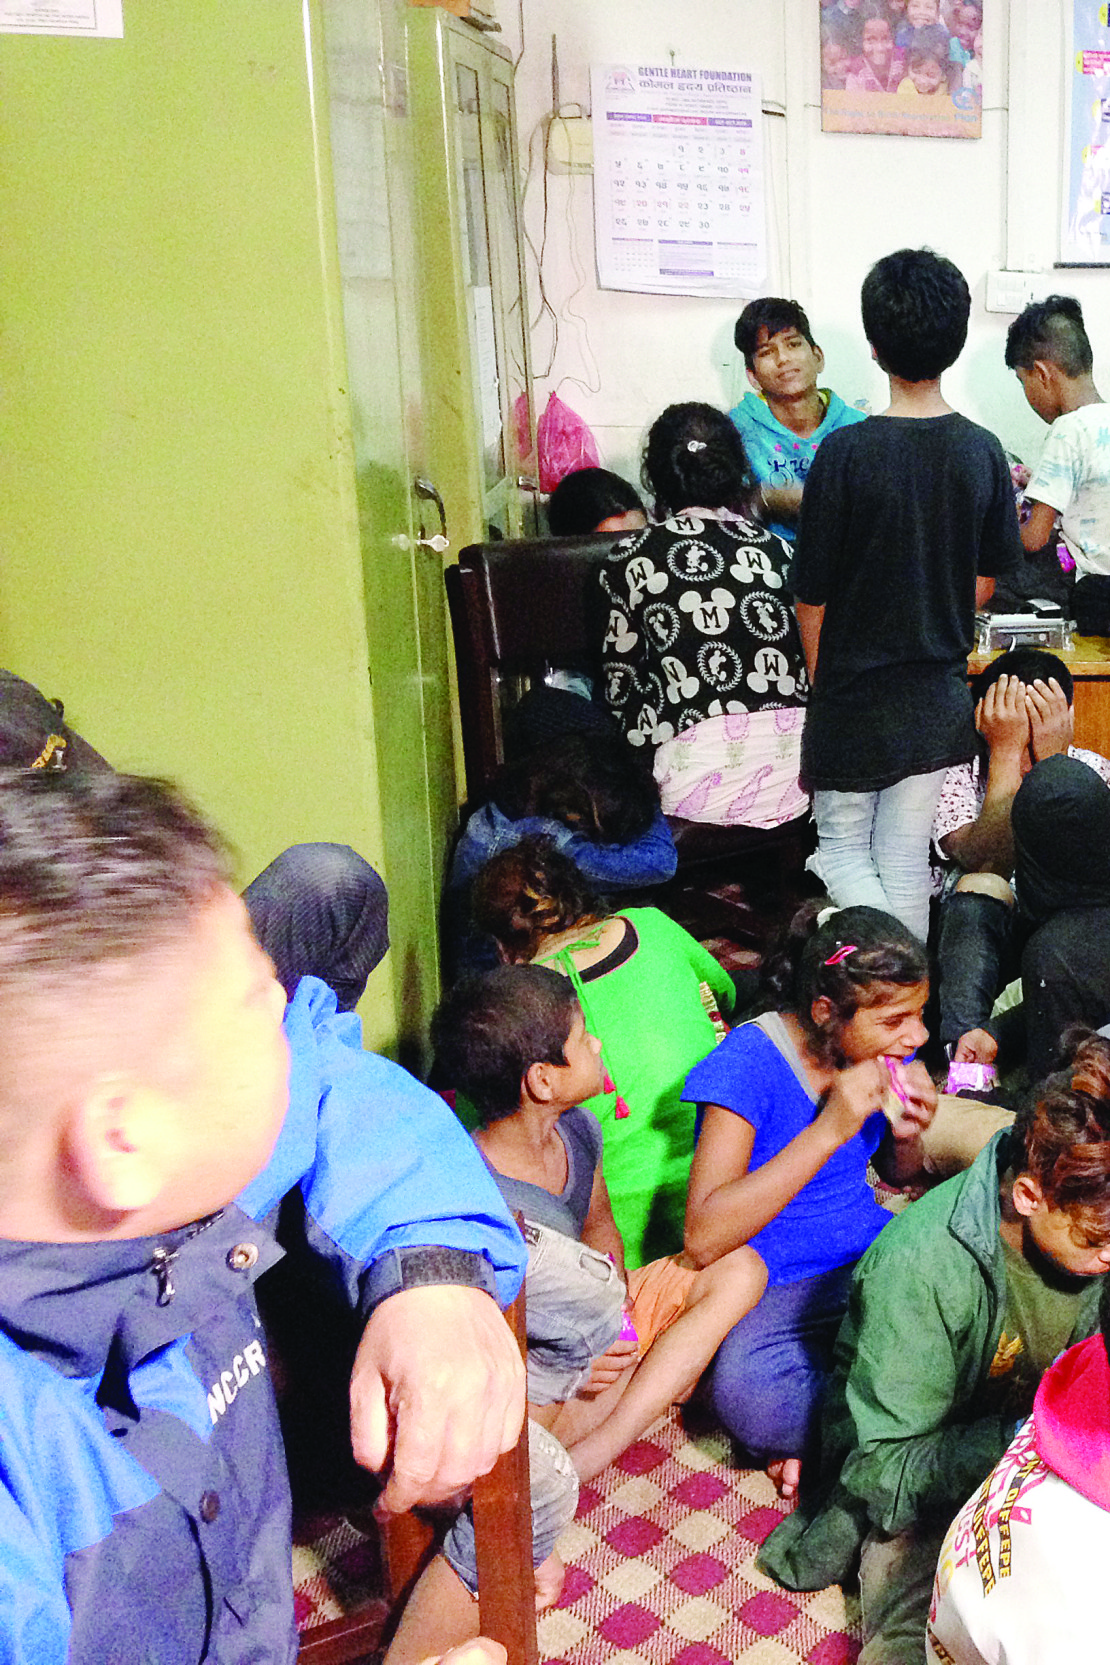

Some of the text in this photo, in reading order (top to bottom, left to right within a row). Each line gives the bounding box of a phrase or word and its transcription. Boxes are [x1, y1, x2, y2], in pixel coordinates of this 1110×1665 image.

[638, 66, 752, 82] GENTLE HEART FOUNDATION
[639, 79, 674, 90] कोमल
[707, 81, 752, 93] प्रतिष्ठान
[703, 607, 720, 629] M
[207, 1340, 266, 1425] NCCR
